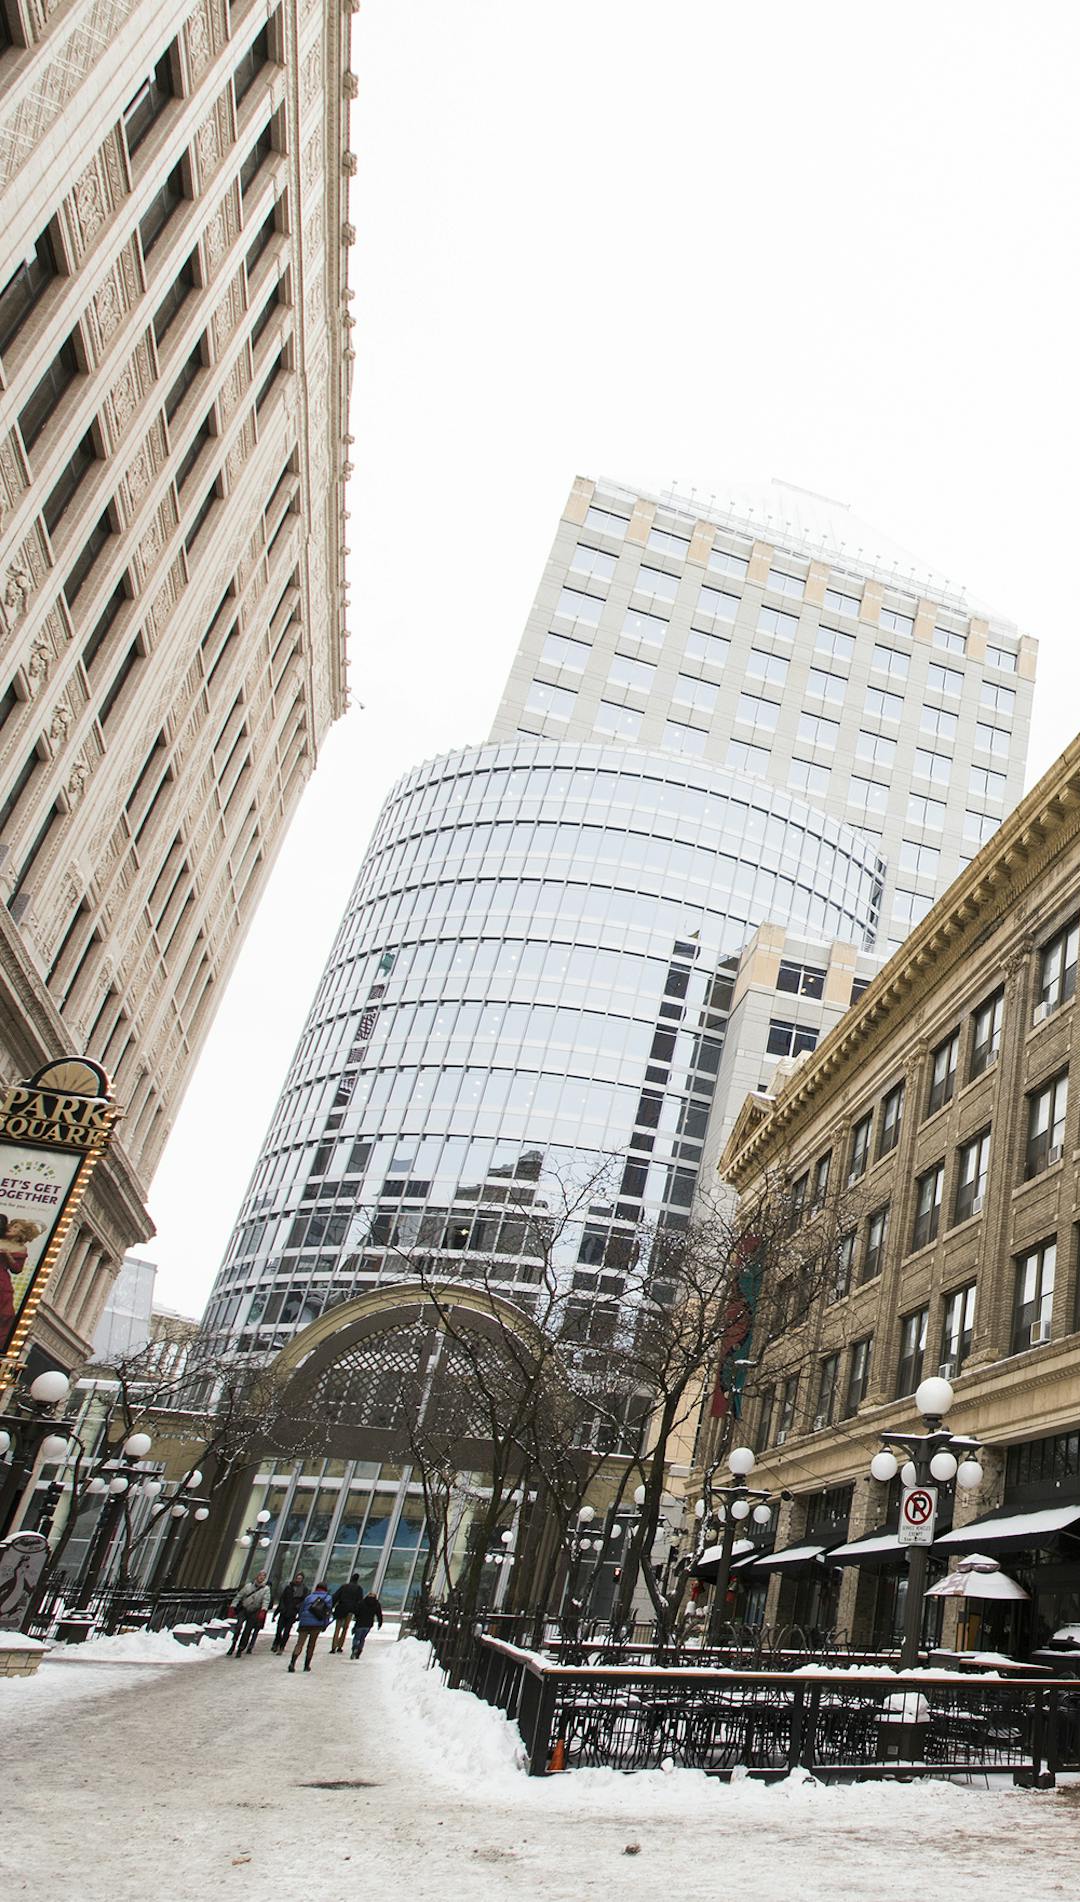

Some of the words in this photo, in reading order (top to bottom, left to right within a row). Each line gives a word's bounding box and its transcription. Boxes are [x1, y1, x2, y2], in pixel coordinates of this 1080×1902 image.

[1, 1087, 114, 1130] PARK
[0, 1178, 31, 1190] ET'S
[34, 1183, 62, 1194] GET
[0, 1188, 58, 1205] OGETHER
